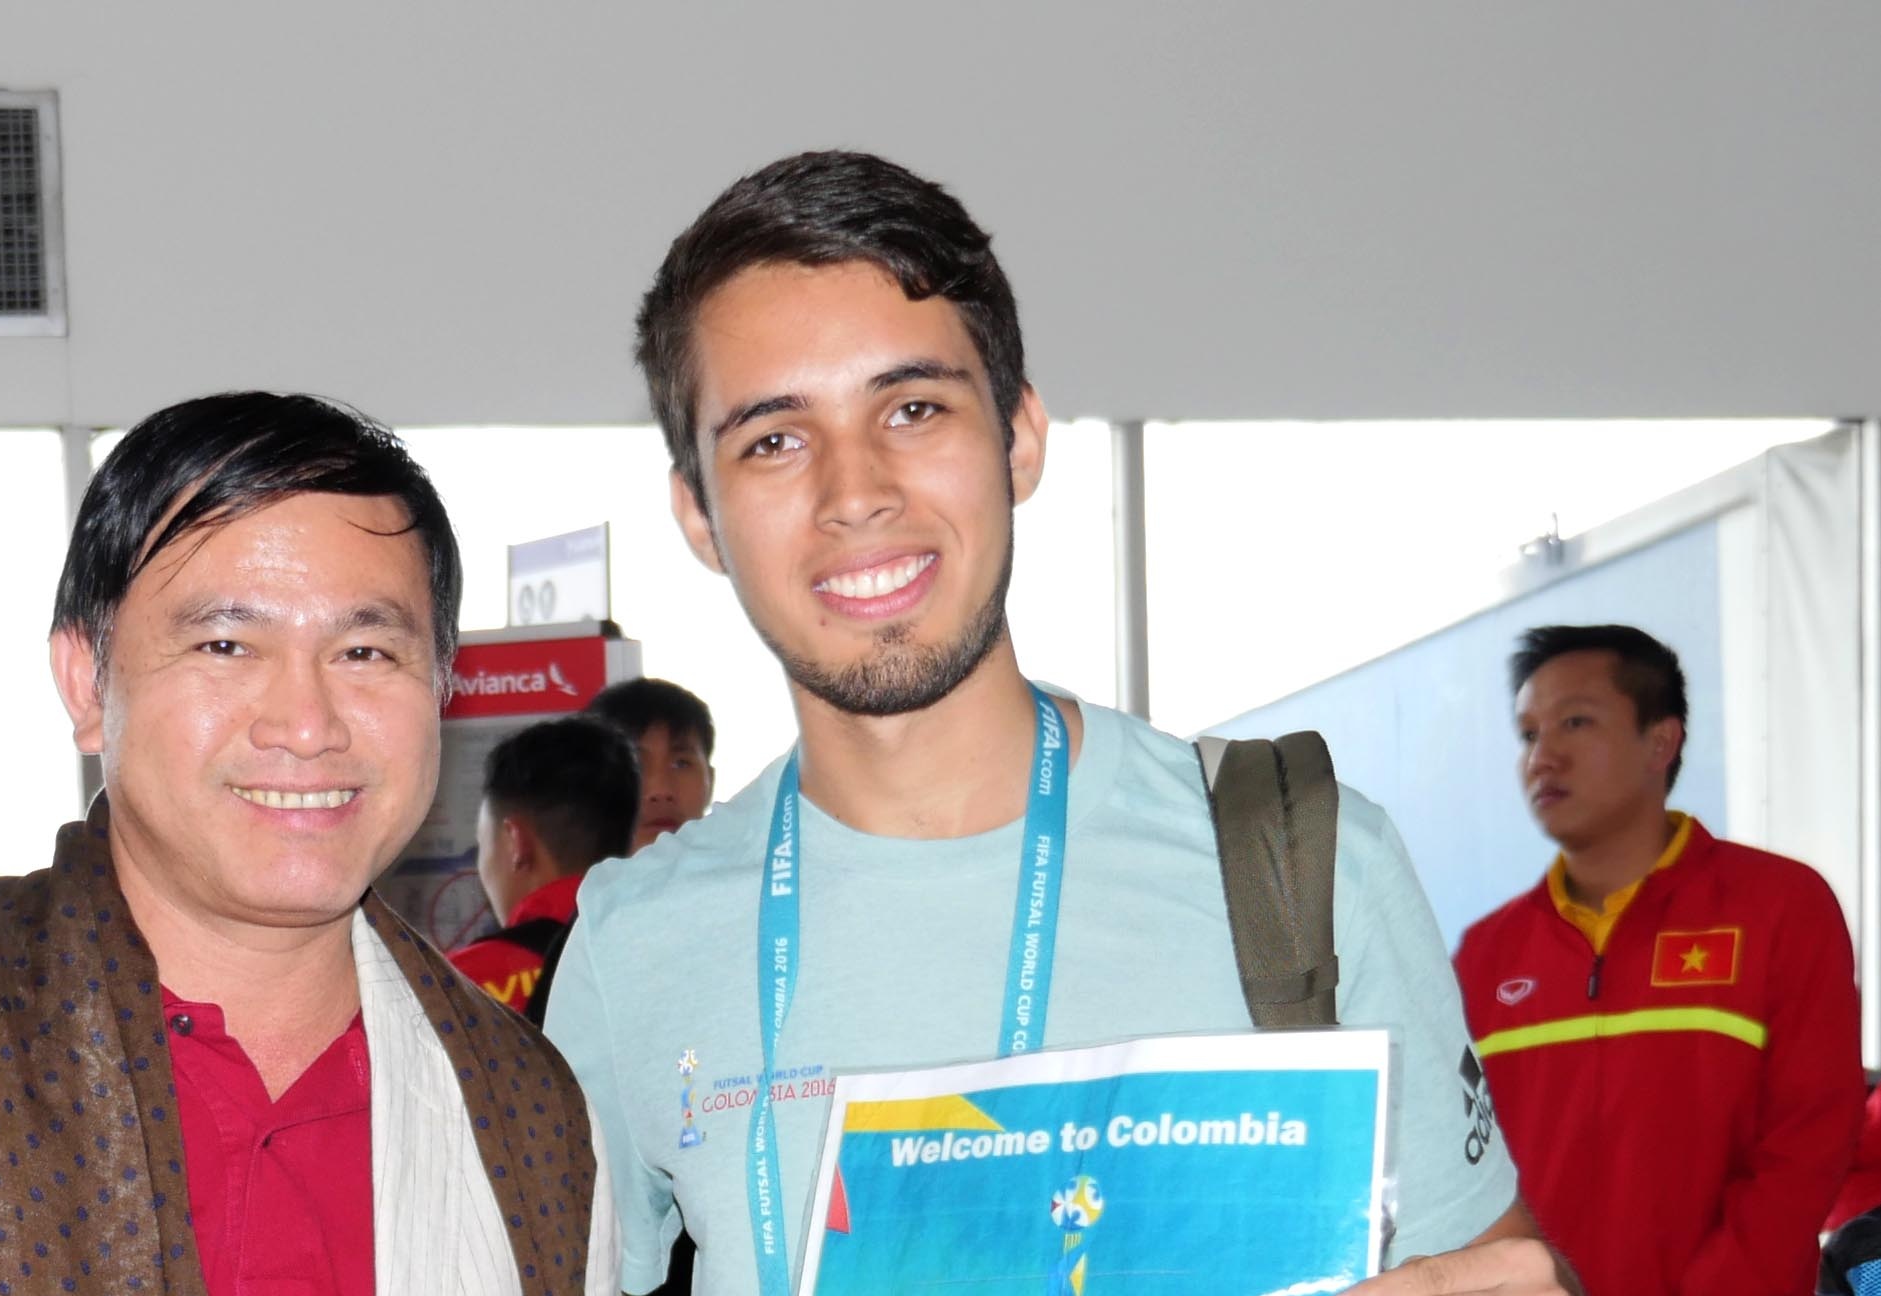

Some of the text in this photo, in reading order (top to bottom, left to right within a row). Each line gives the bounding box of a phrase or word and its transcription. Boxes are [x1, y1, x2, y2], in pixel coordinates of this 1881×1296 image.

[1036, 835, 1050, 867] FIFA
[1028, 874, 1047, 929] FUTSAL
[775, 937, 788, 972] 2016
[1019, 934, 1040, 991] WORLD
[1016, 994, 1031, 1027] CUP
[713, 1074, 751, 1090] FUTSAL
[801, 1064, 823, 1077] CUP
[891, 1112, 1306, 1167] Welcome to Colombia
[758, 1157, 772, 1218] FUTSAL
[764, 1220, 774, 1254] FIFA
